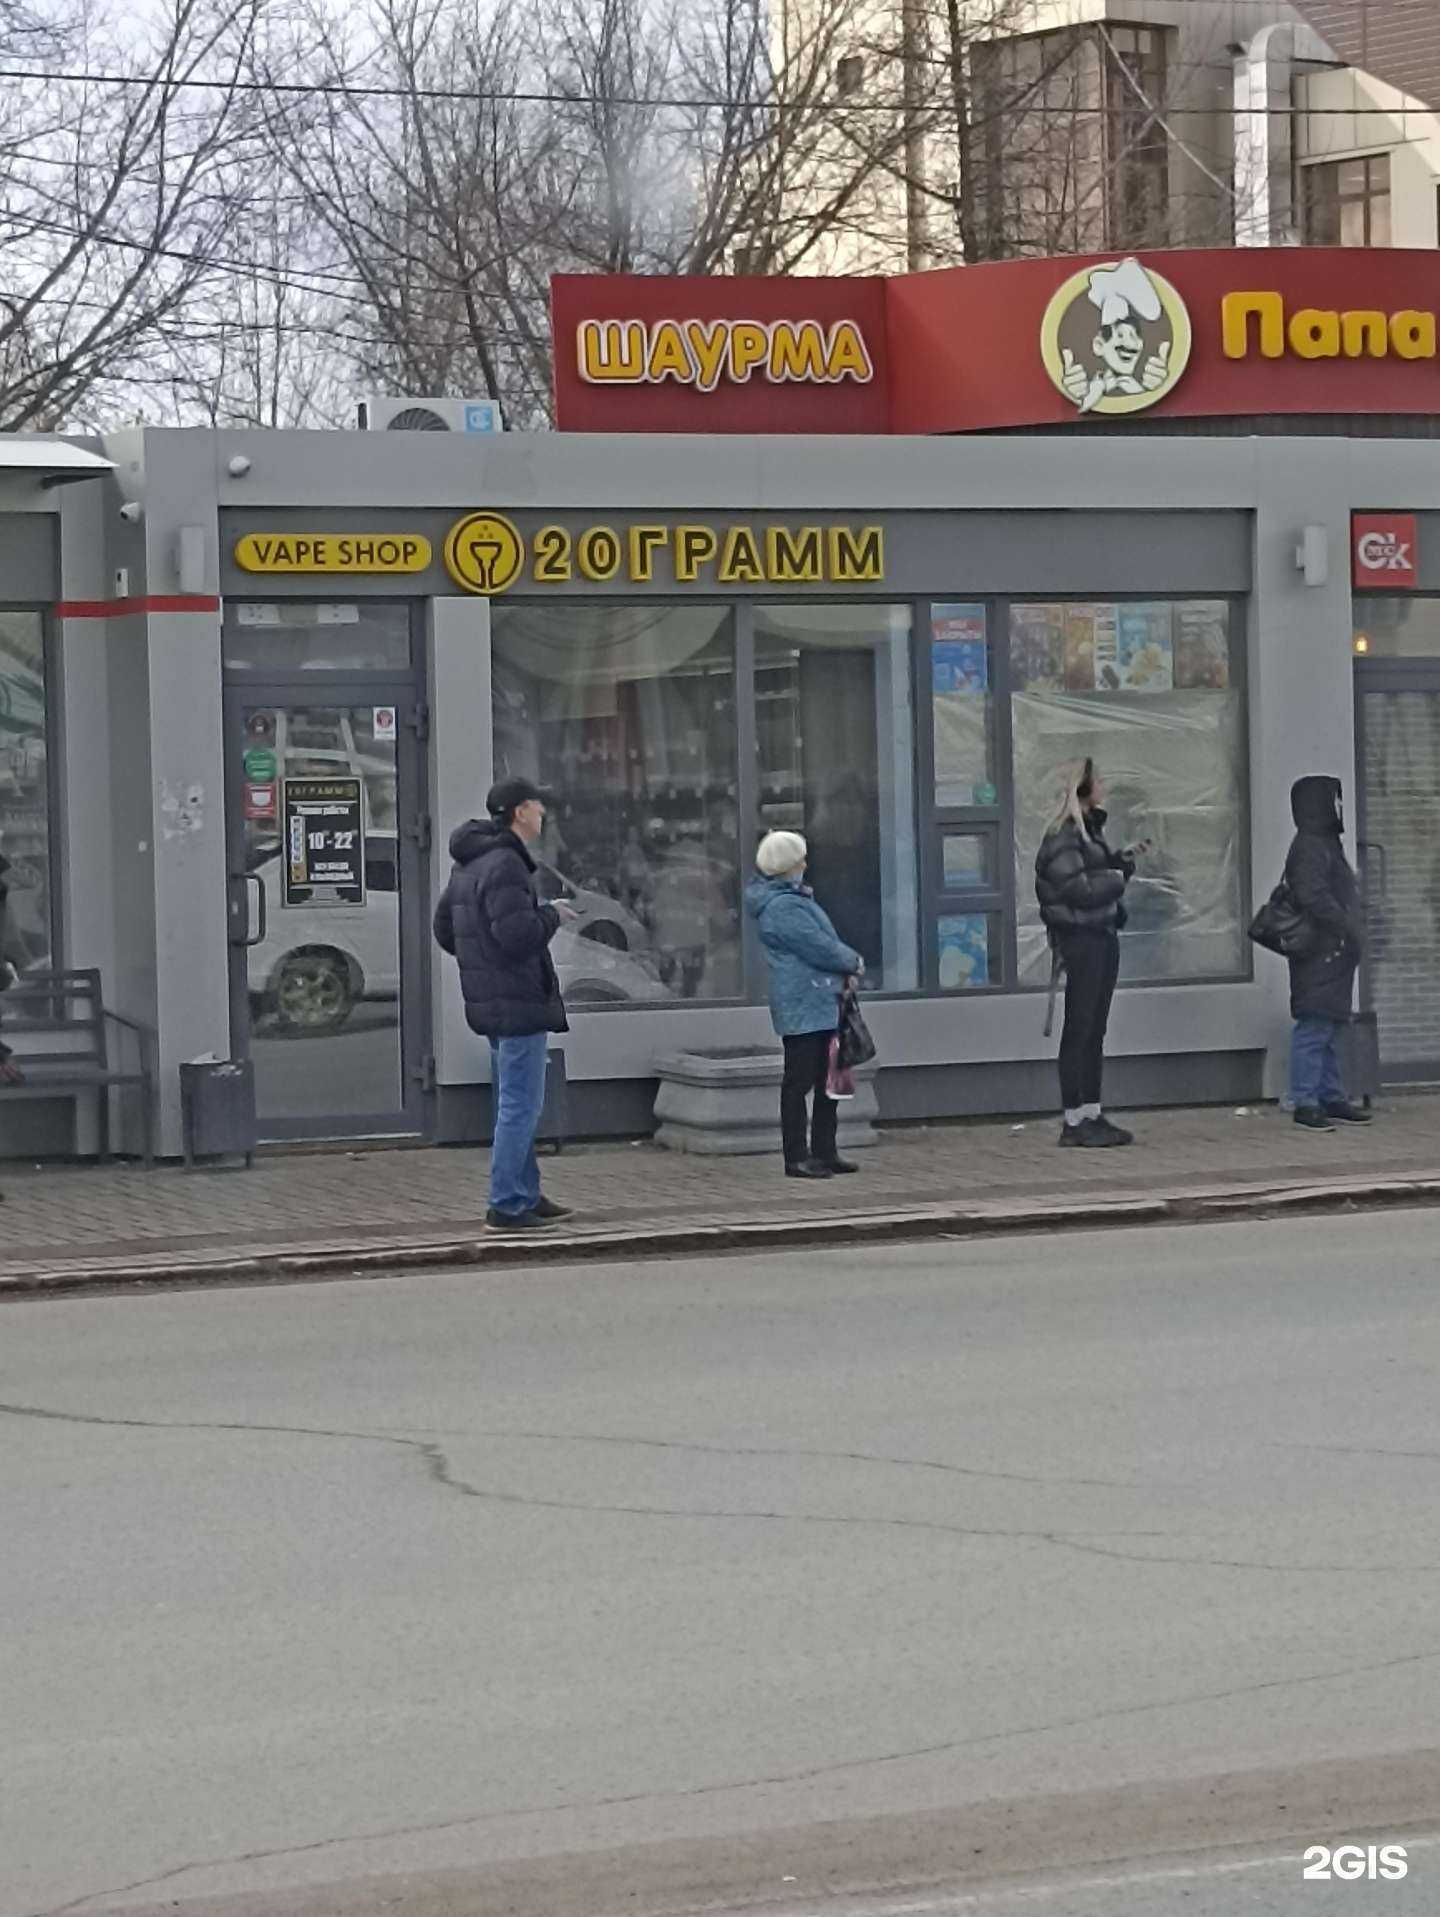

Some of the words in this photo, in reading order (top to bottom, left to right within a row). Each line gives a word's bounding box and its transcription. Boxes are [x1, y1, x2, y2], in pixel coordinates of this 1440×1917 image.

[577, 319, 873, 392] ШАУРМА
[1222, 291, 1436, 359] Папа
[253, 541, 326, 565] VAPE
[338, 540, 417, 565] SHOP
[533, 525, 884, 581] 20ГРАММ
